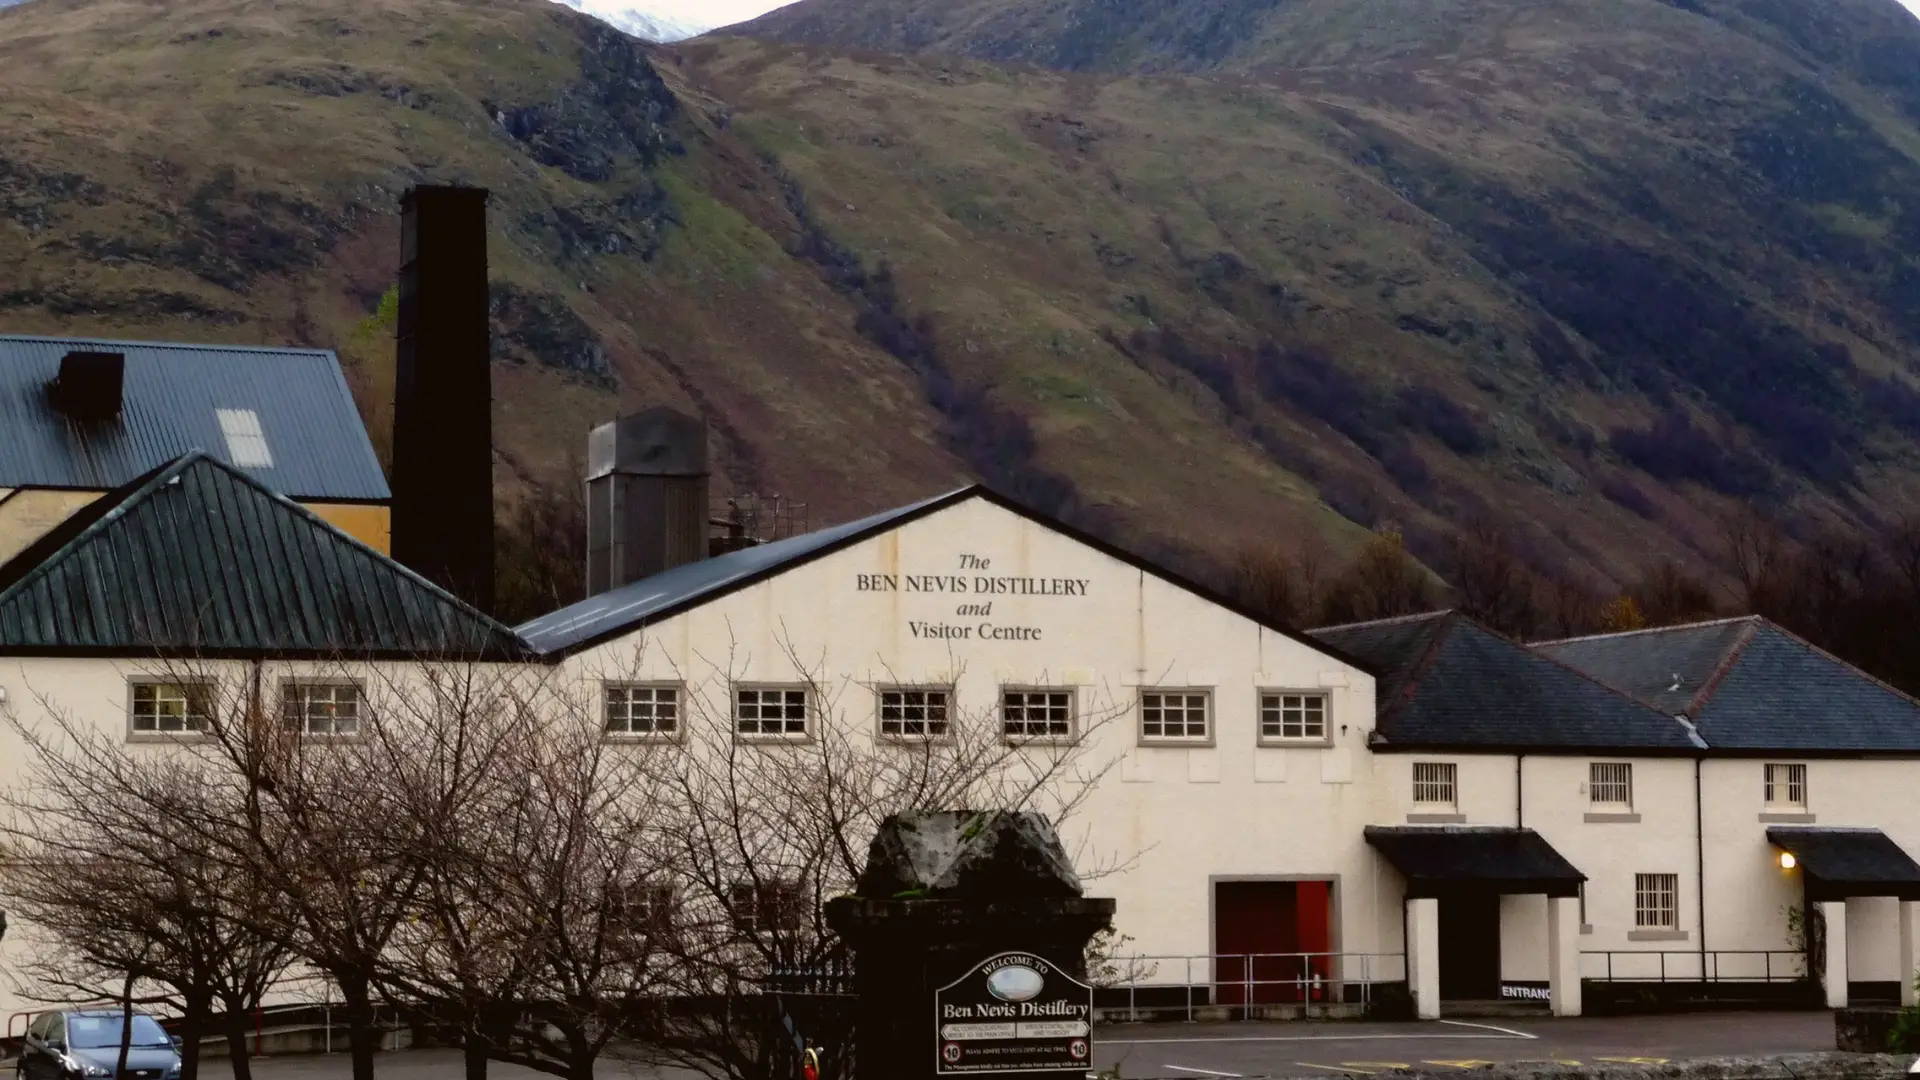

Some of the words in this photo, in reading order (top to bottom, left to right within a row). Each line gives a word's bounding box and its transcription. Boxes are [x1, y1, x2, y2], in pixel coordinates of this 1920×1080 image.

[959, 553, 991, 570] The
[857, 573, 898, 592] BEN
[905, 575, 967, 593] NEVIS
[974, 576, 1090, 597] DISTILLERY
[956, 601, 992, 617] and
[908, 621, 972, 640] Visitor
[978, 622, 1042, 641] Centre
[982, 955, 1033, 975] WELCOME
[1035, 960, 1049, 974] TO
[1502, 985, 1551, 999] ENTRANC
[943, 1004, 973, 1018] Ben
[976, 1002, 1016, 1018] Nevis
[1020, 998, 1089, 1021] Distillery
[946, 1047, 958, 1058] 10
[1073, 1043, 1085, 1055] 10
